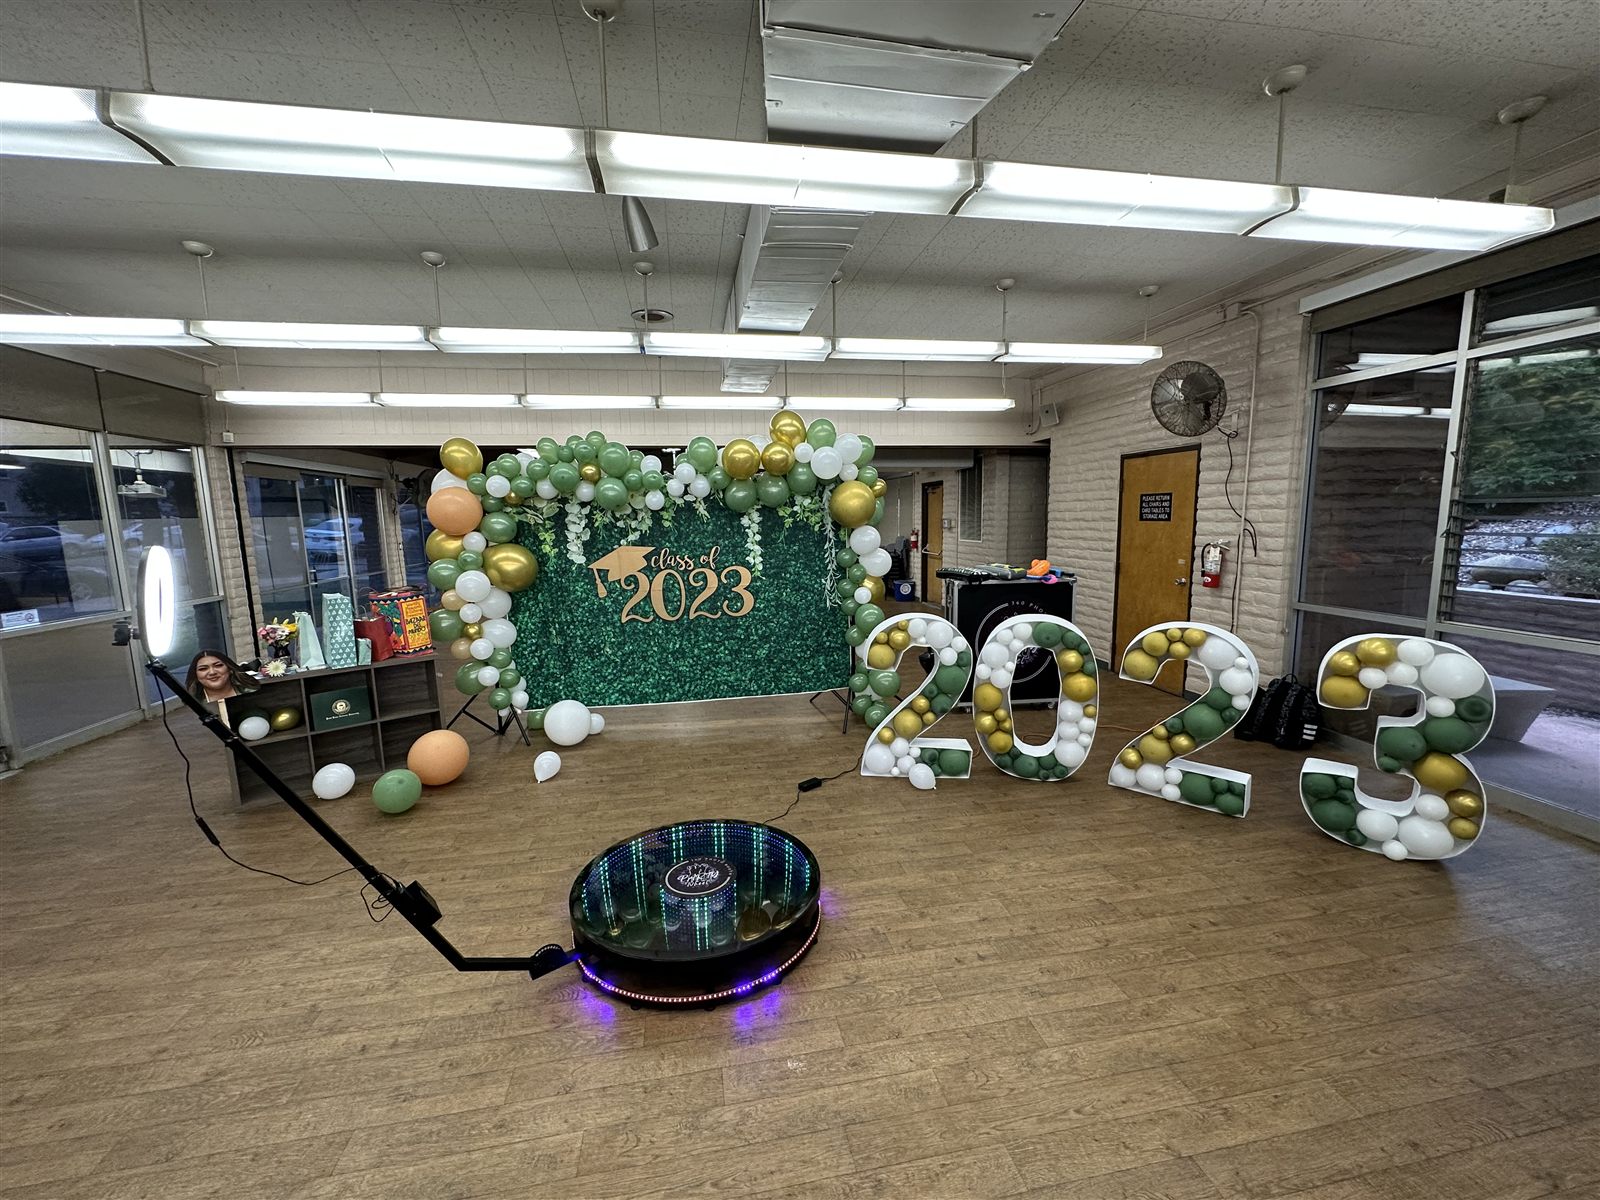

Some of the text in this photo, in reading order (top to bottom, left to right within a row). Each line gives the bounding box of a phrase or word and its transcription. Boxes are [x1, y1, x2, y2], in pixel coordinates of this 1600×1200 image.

[651, 545, 720, 571] class of
[620, 565, 755, 624] 2023
